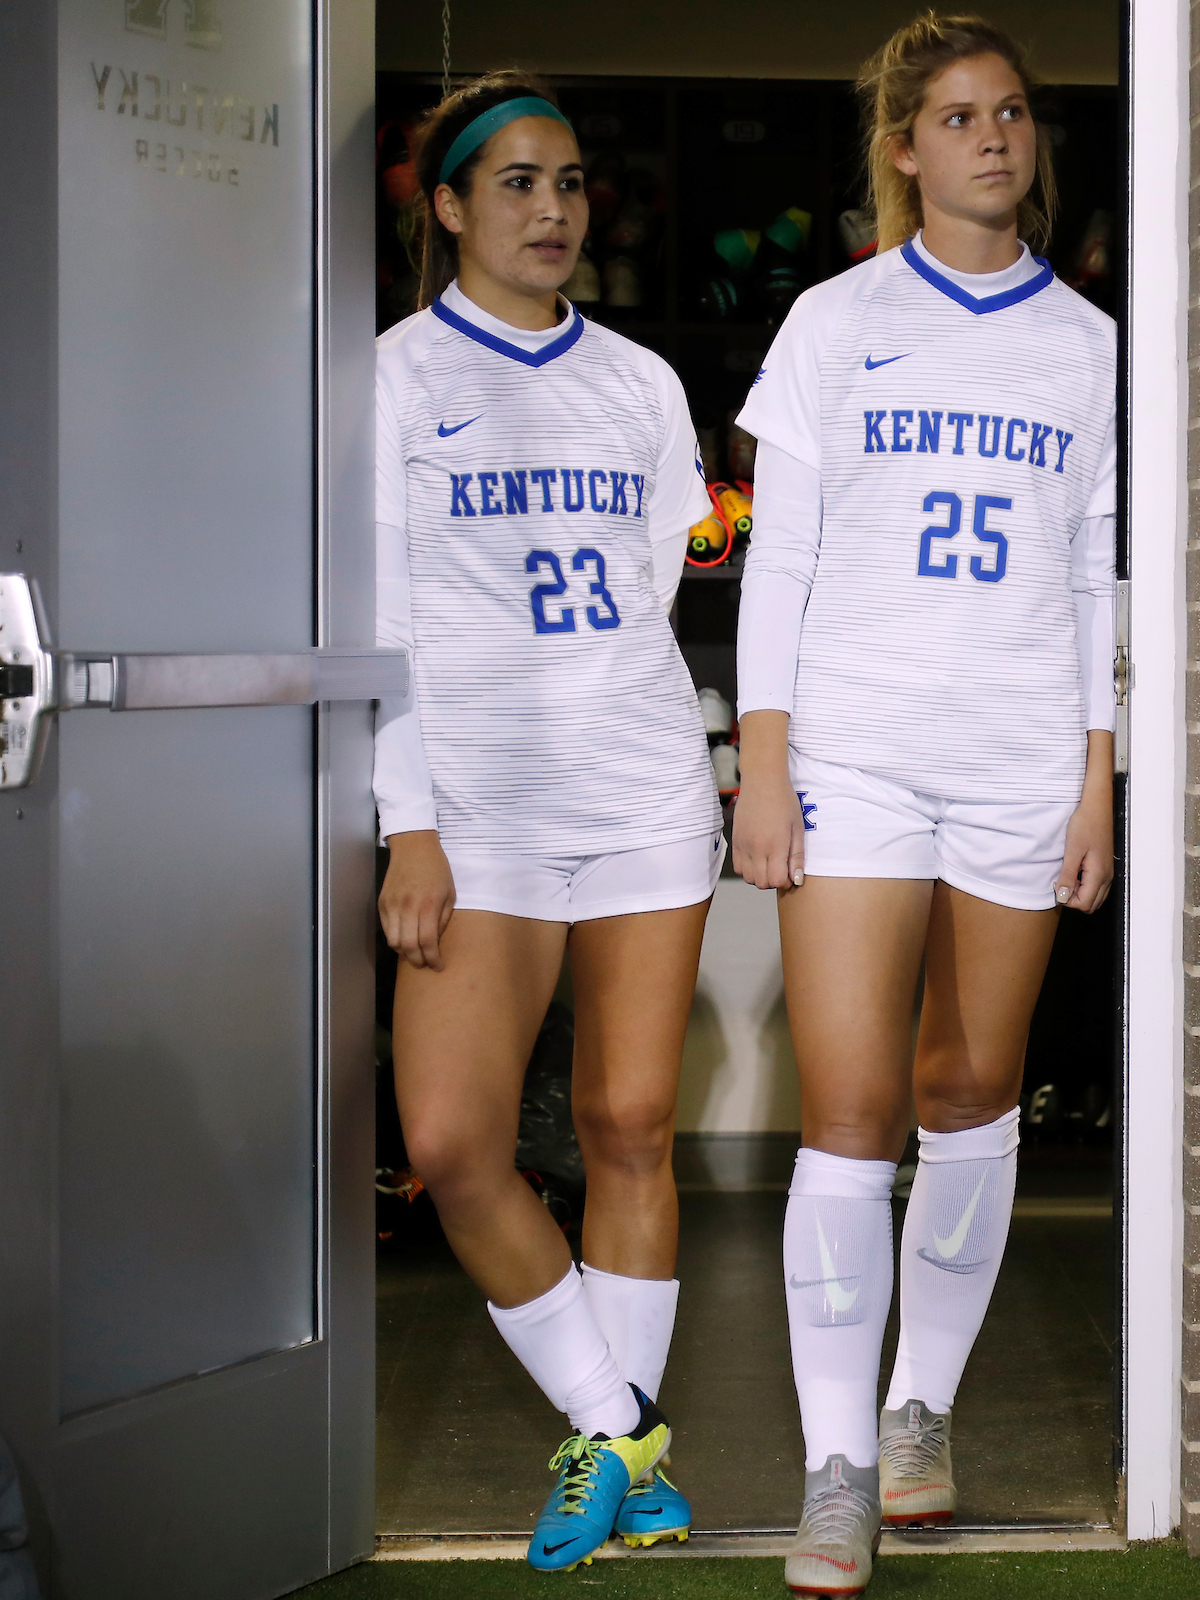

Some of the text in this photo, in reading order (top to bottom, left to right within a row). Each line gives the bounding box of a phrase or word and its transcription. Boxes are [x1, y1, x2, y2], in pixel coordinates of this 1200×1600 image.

[864, 410, 1073, 474] KENTUCKY
[450, 469, 645, 517] KENTUCKY
[916, 489, 1014, 583] 25
[523, 546, 621, 635] 23
